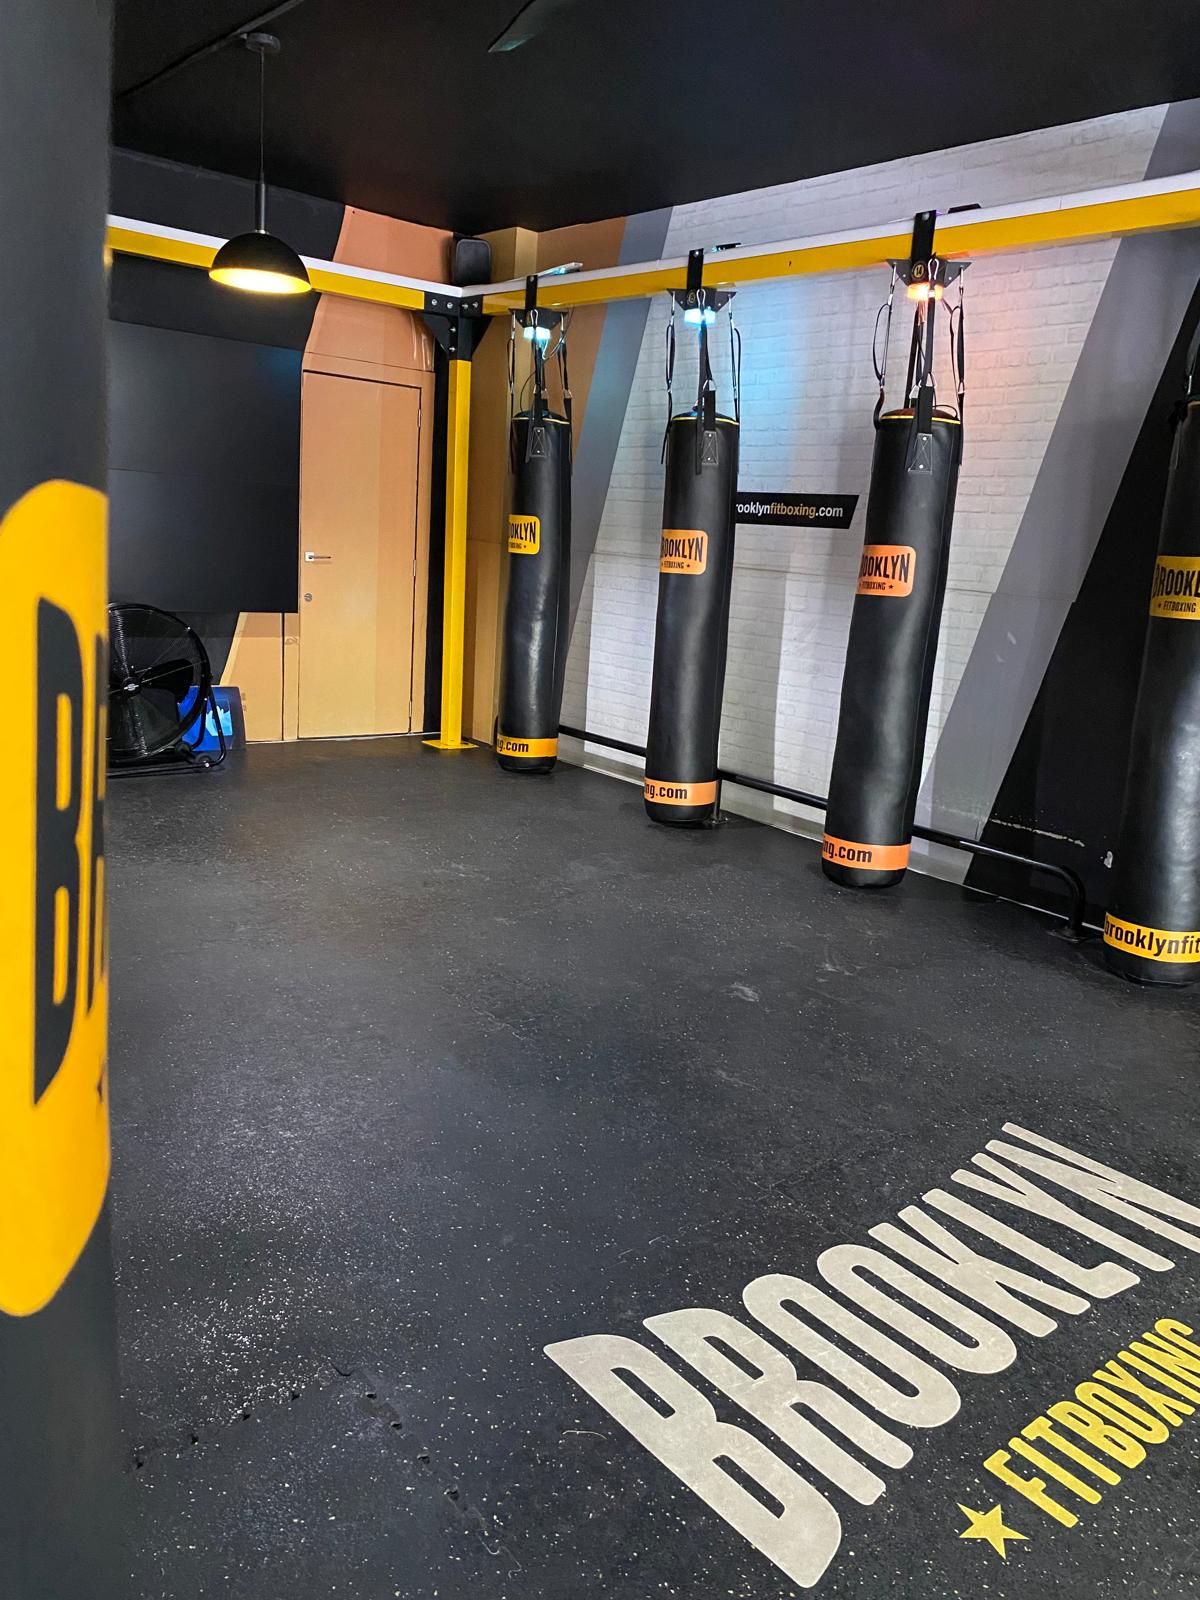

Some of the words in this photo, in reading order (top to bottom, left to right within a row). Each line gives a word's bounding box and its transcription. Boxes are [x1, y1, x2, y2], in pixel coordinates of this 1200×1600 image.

[736, 501, 843, 519] ooklynfitboxing.com
[498, 739, 529, 752] g.com
[543, 1122, 1200, 1588] BROOKLYN
